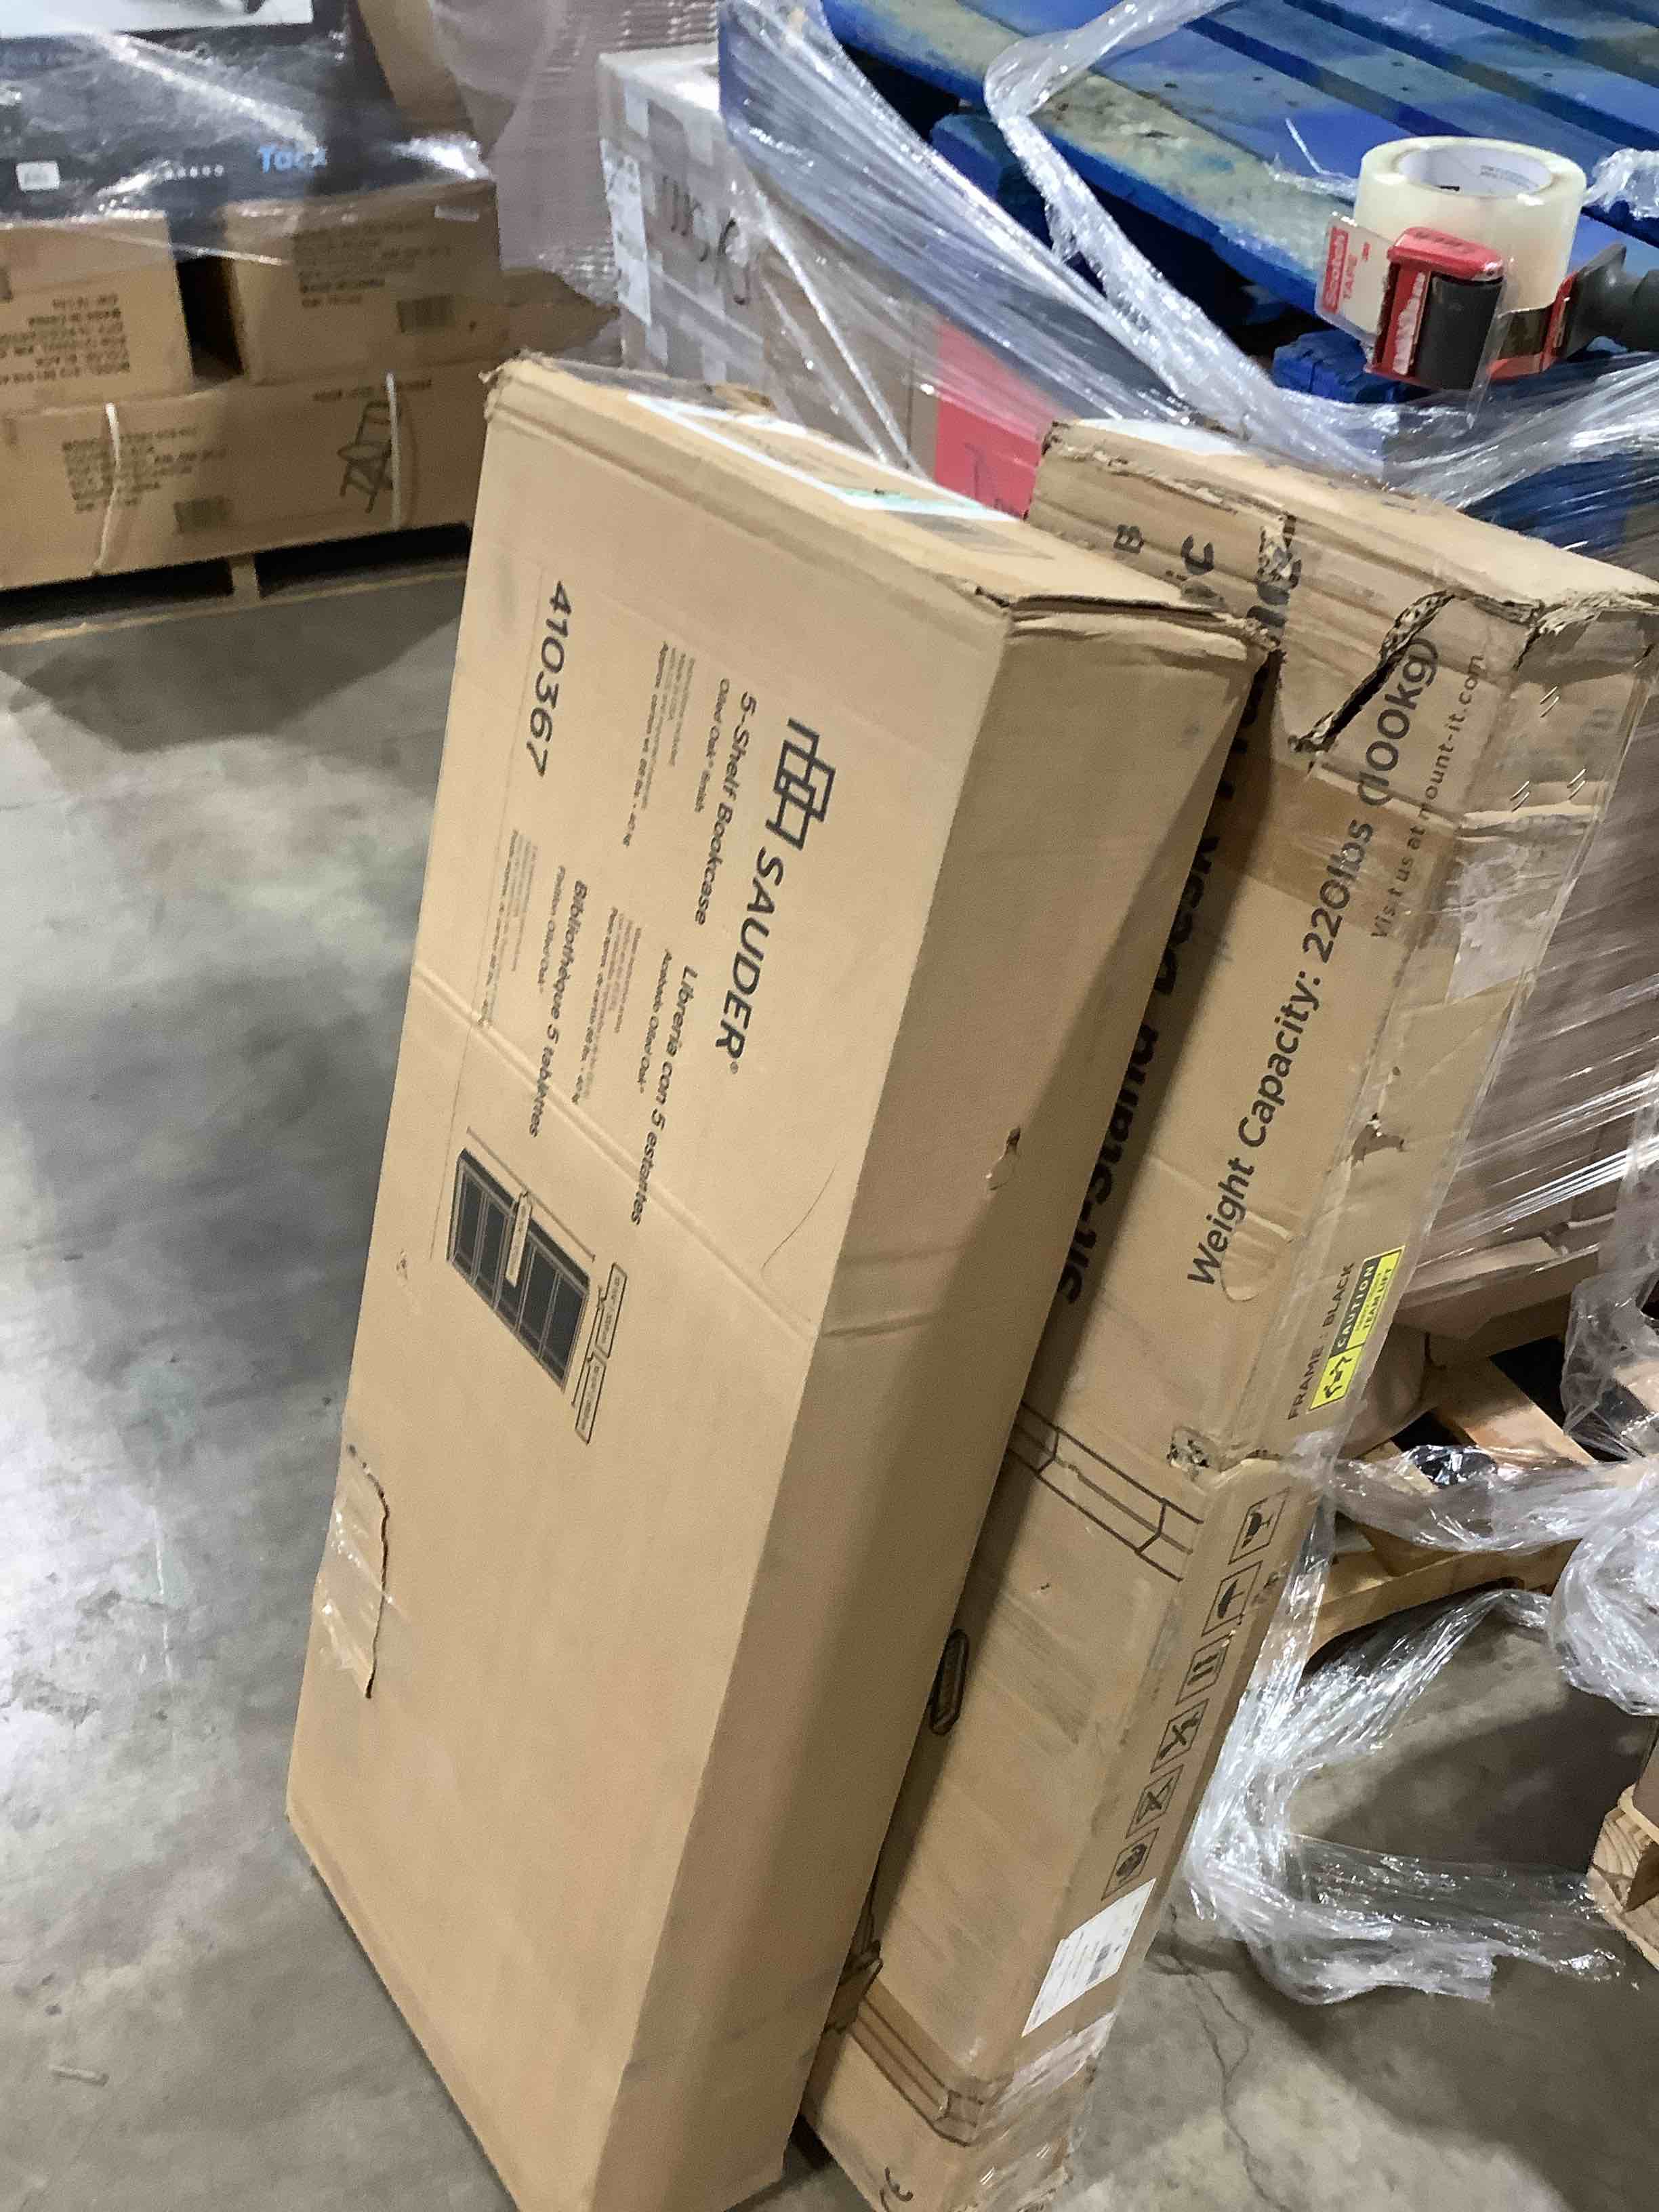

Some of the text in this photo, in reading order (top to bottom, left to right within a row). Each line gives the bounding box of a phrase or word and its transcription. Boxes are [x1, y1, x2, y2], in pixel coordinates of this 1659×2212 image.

[526, 581, 572, 778] 410367
[695, 691, 757, 926] 5-Shelf Bookcase
[1371, 887, 1404, 938] Vist
[1396, 857, 1414, 882] us
[1408, 826, 1427, 850] at
[1187, 636, 1439, 1284] Weight Capacity: 220lbs (100kg)
[547, 1024, 560, 1044] 5
[651, 1108, 665, 1131] 5
[656, 1061, 672, 1106] con
[1287, 1346, 1324, 1420] FRAME
[1322, 1263, 1355, 1327] BLACK
[1337, 1265, 1374, 1348] CAUTION
[1364, 1294, 1381, 1330] TEAM
[1376, 1268, 1392, 1294] LIFT
